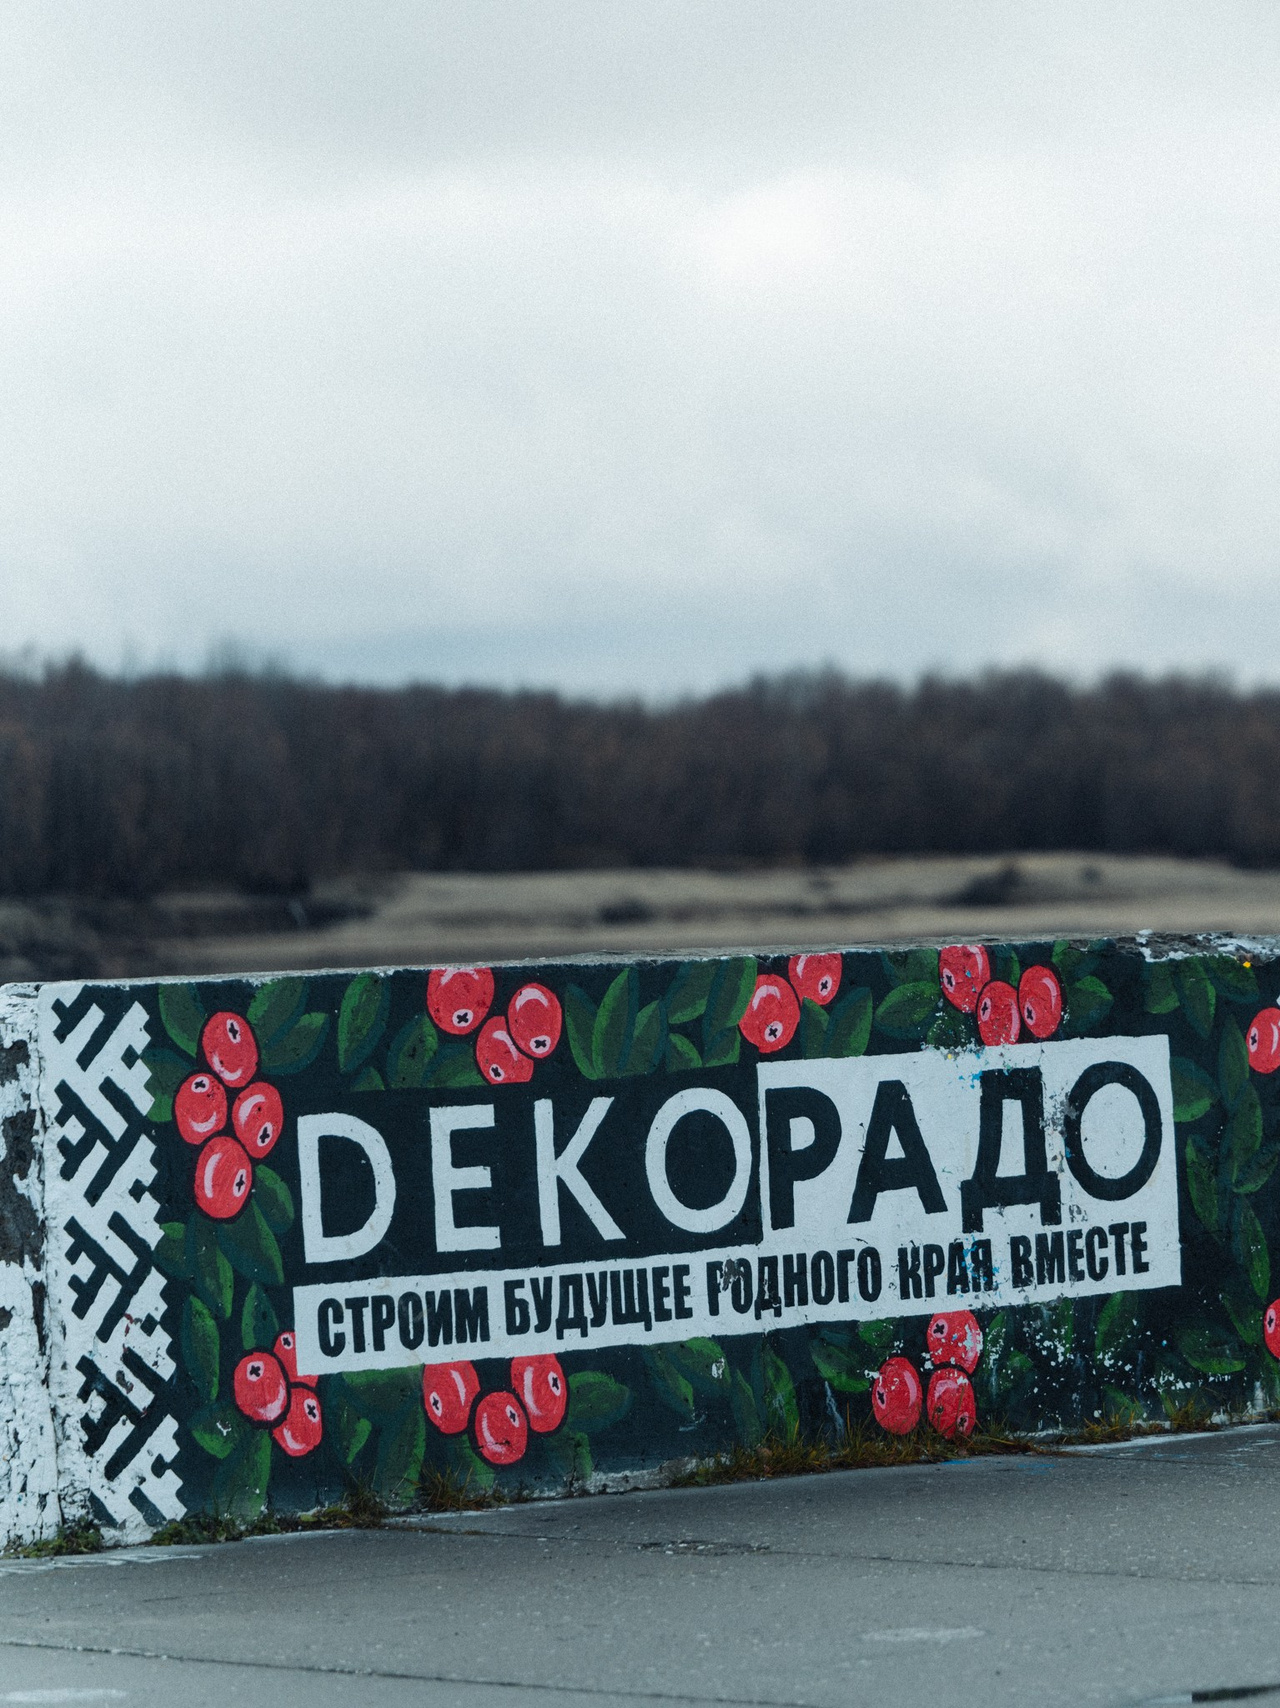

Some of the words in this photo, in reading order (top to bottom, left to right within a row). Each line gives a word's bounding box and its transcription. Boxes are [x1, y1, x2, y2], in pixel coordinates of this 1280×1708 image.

[318, 1286, 491, 1358] СТРОИМ
[504, 1266, 693, 1340] БУДУЩЕЕ
[706, 1246, 883, 1320] РОДНОГО
[897, 1238, 994, 1301] КРАЯ
[1010, 1221, 1150, 1290] ВМЕСТЕ
